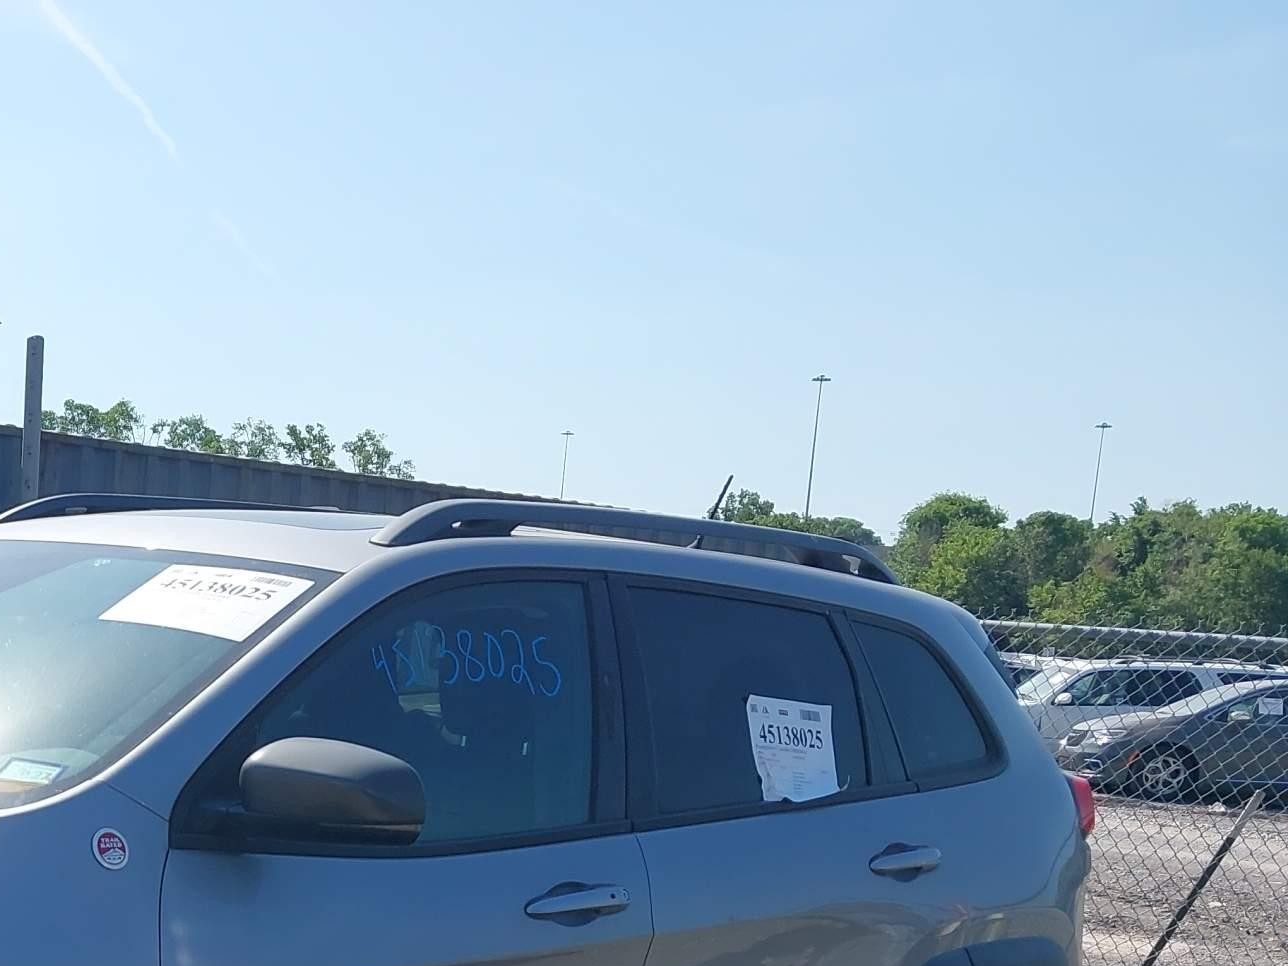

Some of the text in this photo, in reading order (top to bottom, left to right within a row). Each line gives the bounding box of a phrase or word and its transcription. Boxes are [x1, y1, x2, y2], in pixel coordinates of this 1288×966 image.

[160, 578, 278, 601] 45138025
[371, 624, 561, 697] 45138025
[759, 722, 824, 750] 45138025
